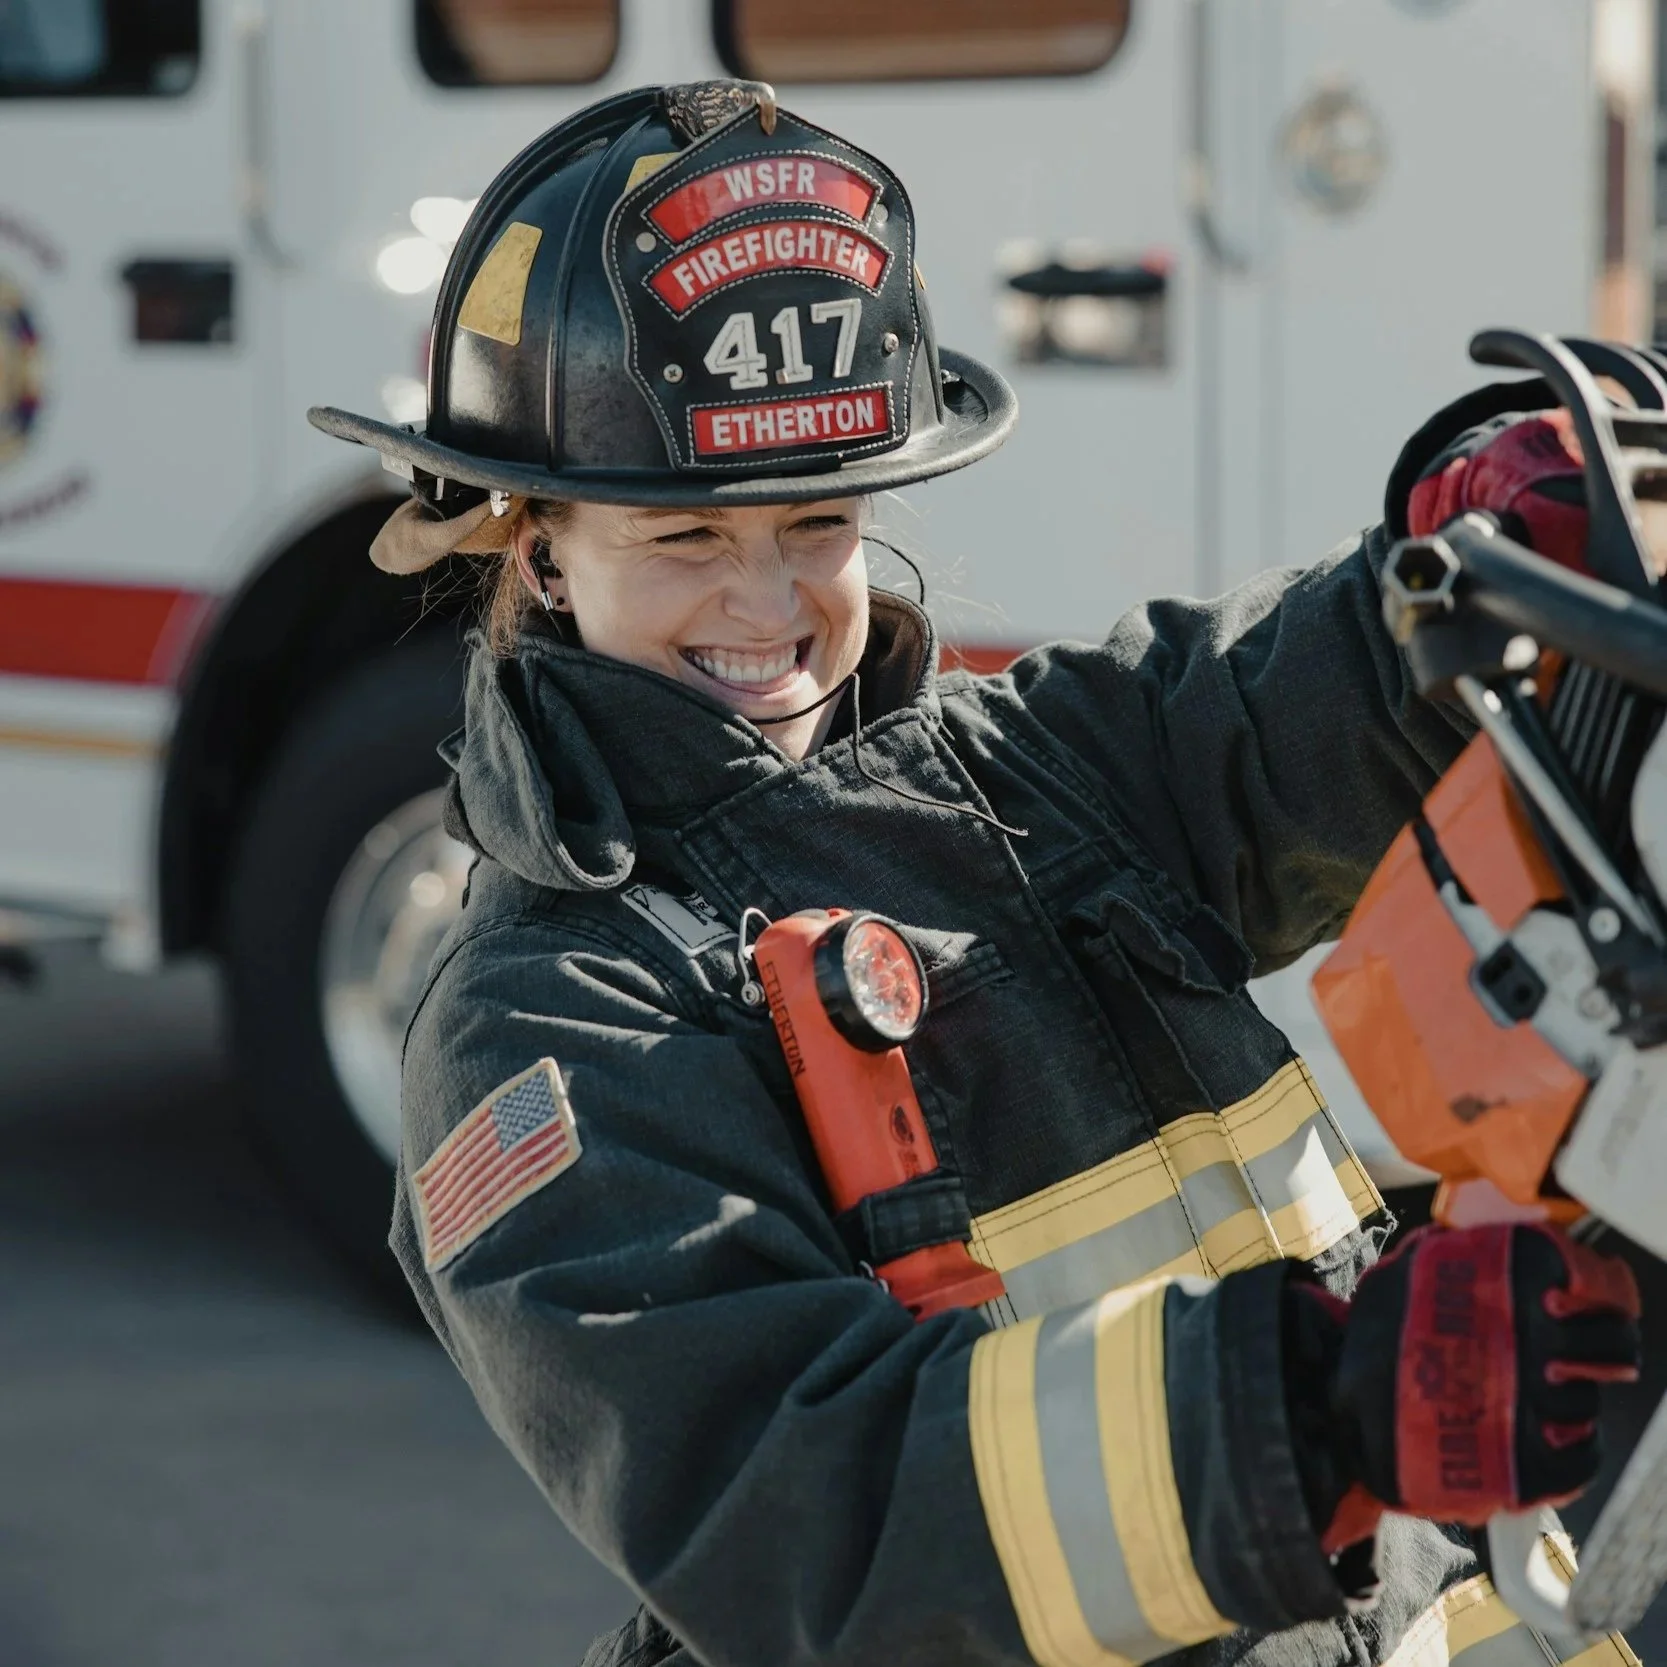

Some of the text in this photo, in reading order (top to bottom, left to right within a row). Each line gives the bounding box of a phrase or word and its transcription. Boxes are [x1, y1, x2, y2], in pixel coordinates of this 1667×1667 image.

[724, 161, 816, 201] WSFR
[672, 227, 870, 297] FIREFIGHTER
[703, 298, 862, 390] 417
[711, 396, 875, 447] ETHERTON
[761, 960, 806, 1079] ETHERTON
